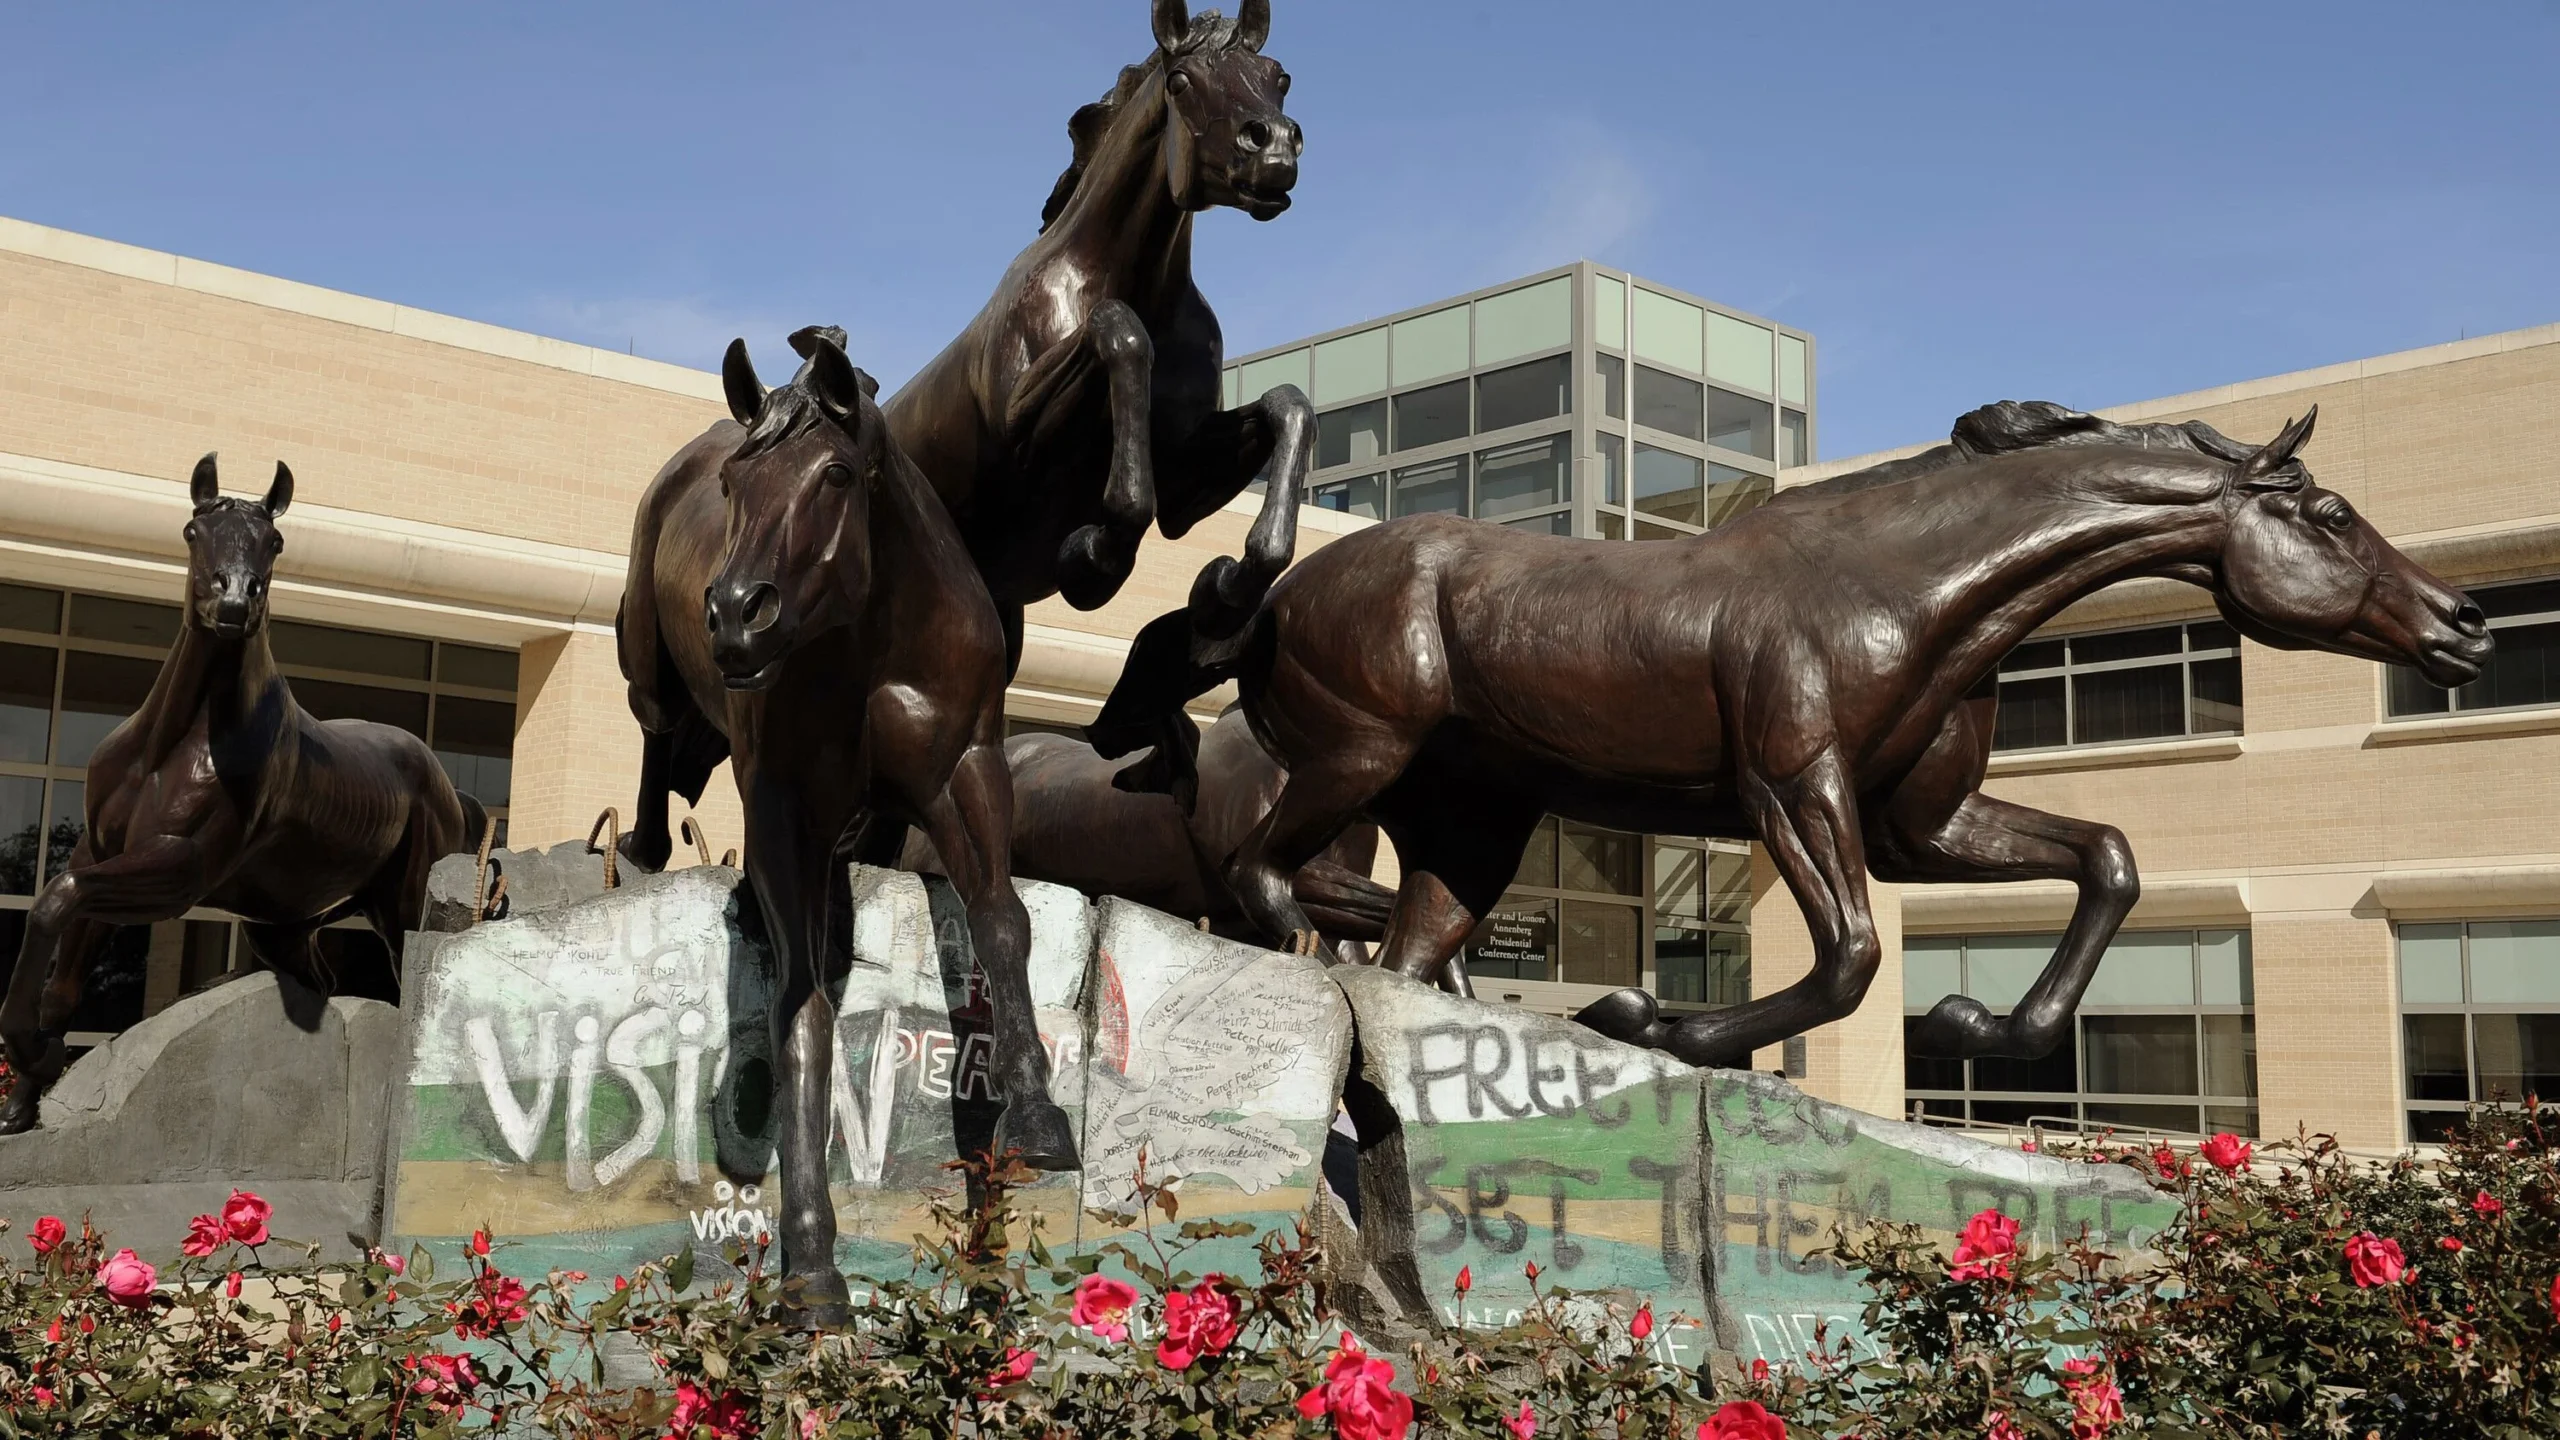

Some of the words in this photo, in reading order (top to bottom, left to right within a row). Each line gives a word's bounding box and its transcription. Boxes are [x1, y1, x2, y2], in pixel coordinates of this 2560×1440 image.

[1502, 911, 1516, 921] and
[1518, 911, 1547, 924] Leonore
[1493, 923, 1532, 936] Annenberg
[1490, 936, 1532, 949] Presidential
[1478, 947, 1519, 960] Conference
[1521, 951, 1545, 962] Center
[632, 964, 677, 977] FRIEND
